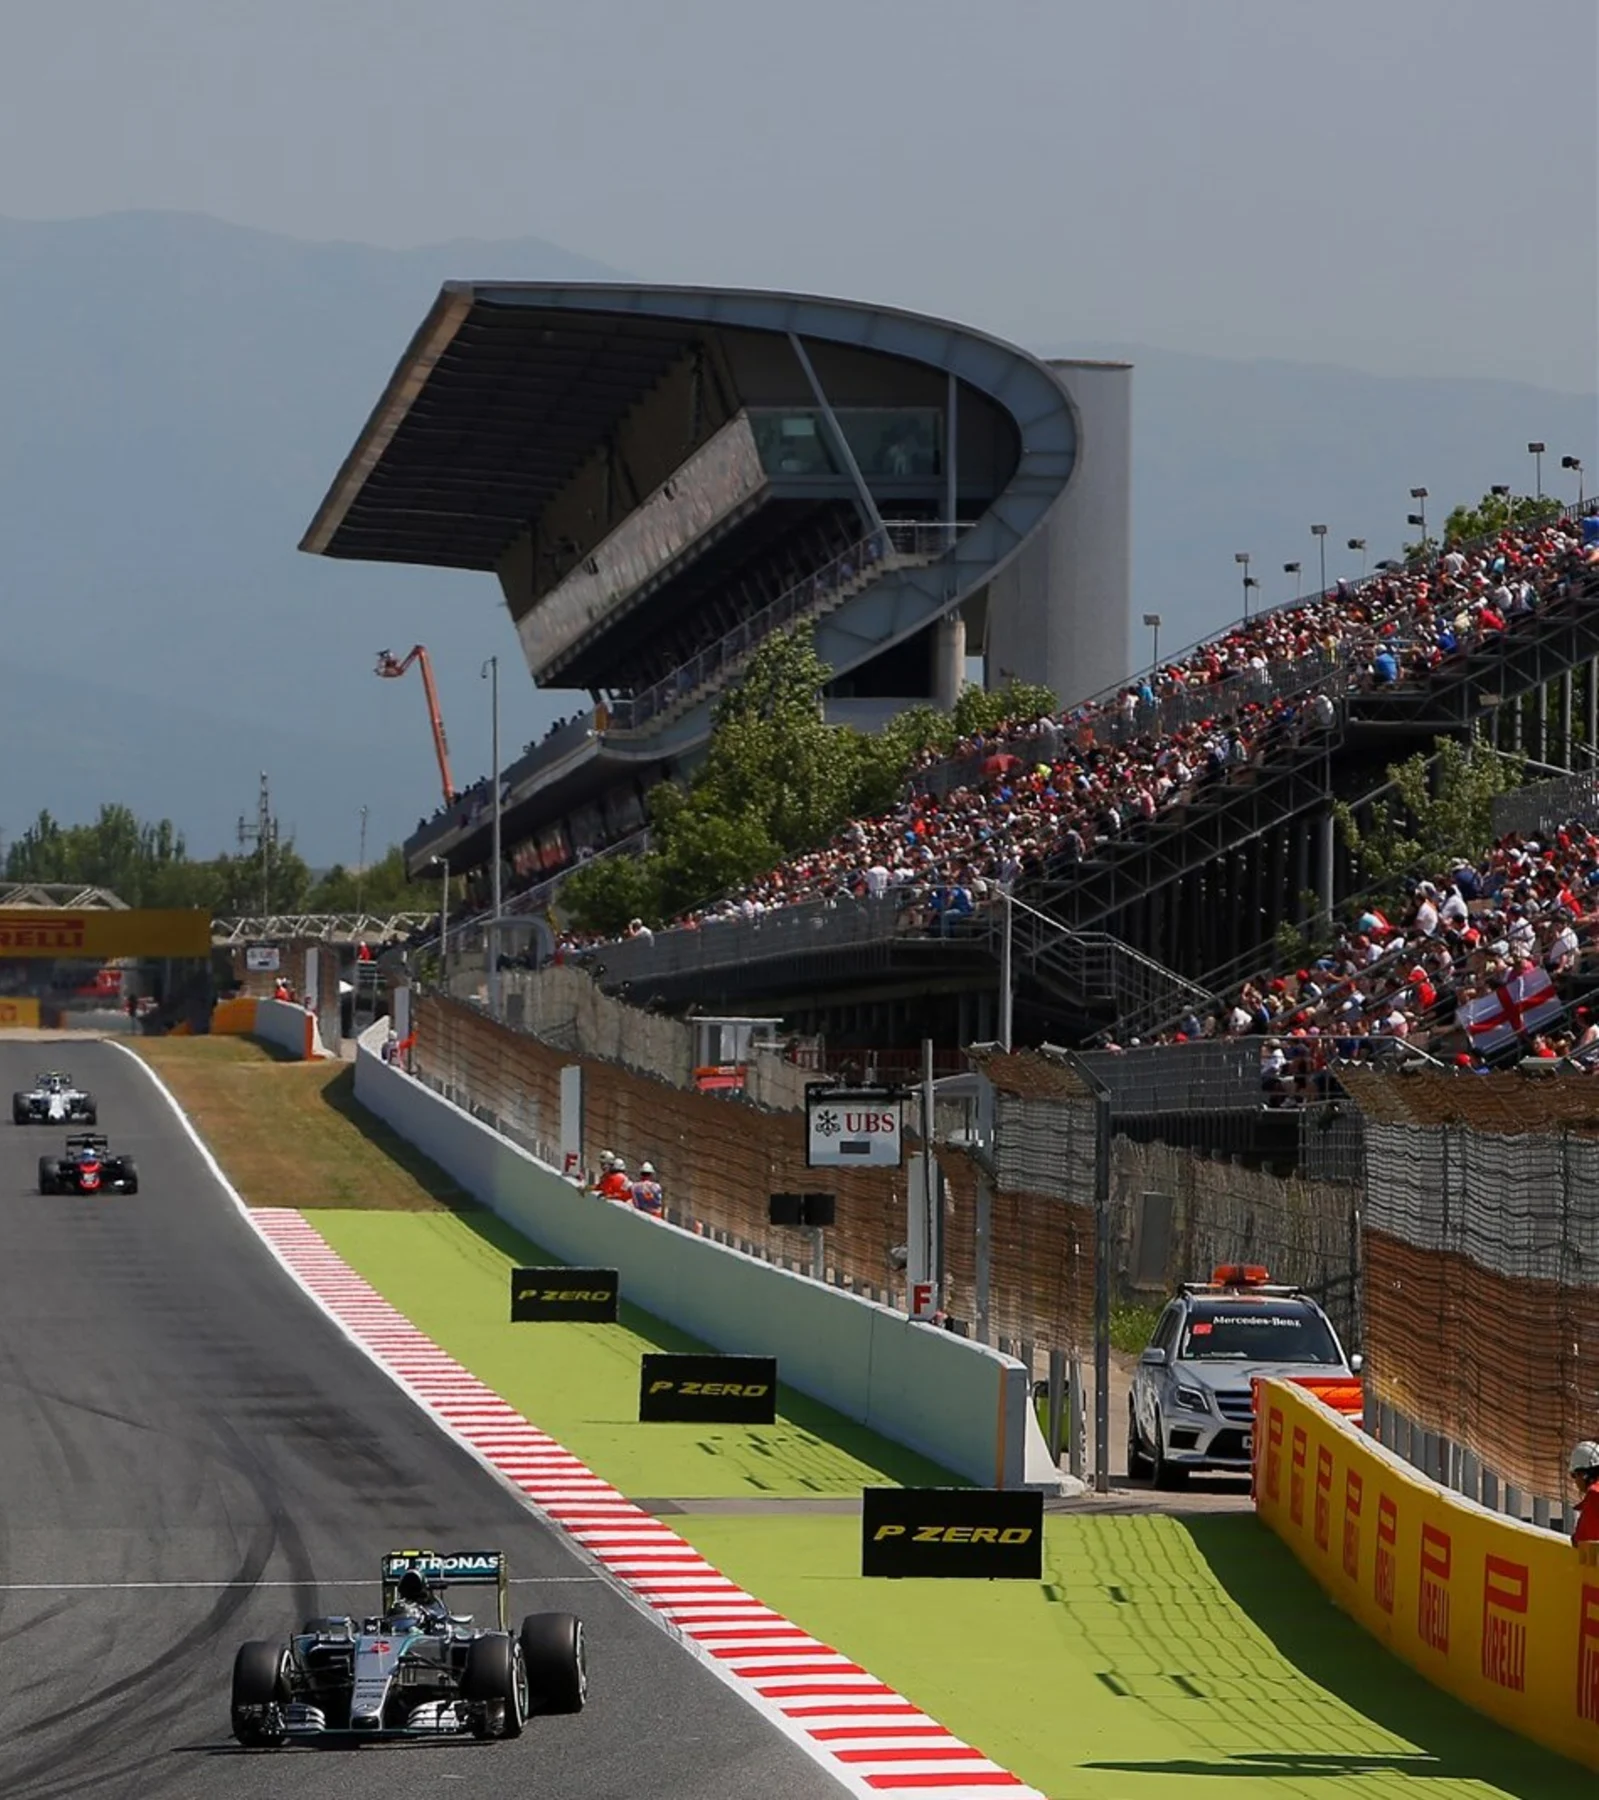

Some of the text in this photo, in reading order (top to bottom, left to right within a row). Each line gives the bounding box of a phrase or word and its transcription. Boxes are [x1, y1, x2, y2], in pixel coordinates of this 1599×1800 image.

[845, 1112, 895, 1133] UBS
[564, 1152, 578, 1172] F
[518, 1289, 611, 1301] P ZERO
[913, 1285, 931, 1314] F
[1213, 1316, 1302, 1328] Mercedes-Benz
[650, 1381, 769, 1397] P ZERO
[873, 1525, 1033, 1544] P ZERO
[1482, 1553, 1529, 1693] PIRELLI
